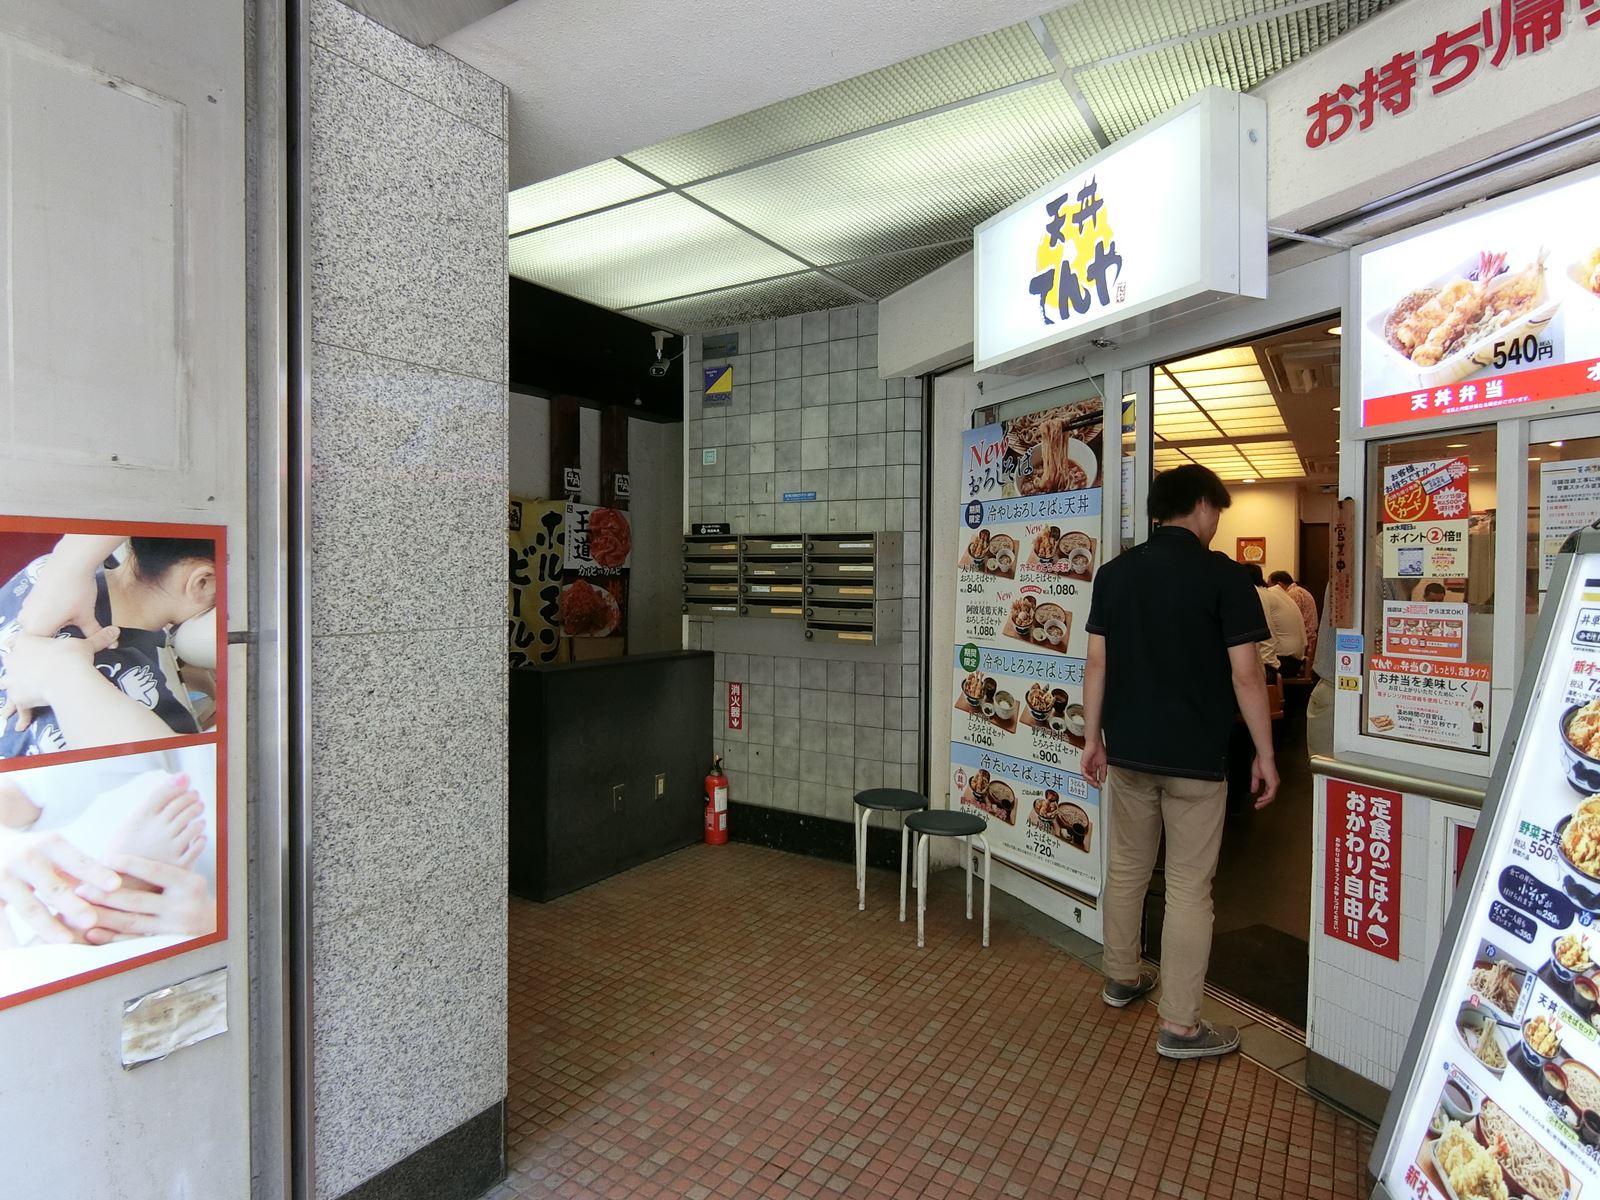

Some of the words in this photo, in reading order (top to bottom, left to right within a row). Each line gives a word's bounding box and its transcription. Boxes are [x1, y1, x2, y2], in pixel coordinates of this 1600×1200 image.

[1029, 240, 1123, 326] てんや
[1410, 379, 1504, 412] 天丼弁当
[968, 437, 1010, 474] New
[968, 447, 1034, 497] おろしそば
[987, 494, 1089, 521] 冷やしおろしそばと天丼
[1397, 498, 1422, 518] カード
[573, 509, 593, 562] 王道
[1024, 524, 1043, 537] New
[1378, 672, 1469, 693] お弁当を美味しく
[730, 684, 741, 718] 消火器
[979, 752, 1064, 791] 冷たいそばと天丼
[1518, 819, 1563, 849] 野菜天丼
[1367, 796, 1391, 923] 定食のごはん
[1537, 992, 1558, 1014] 天丼
